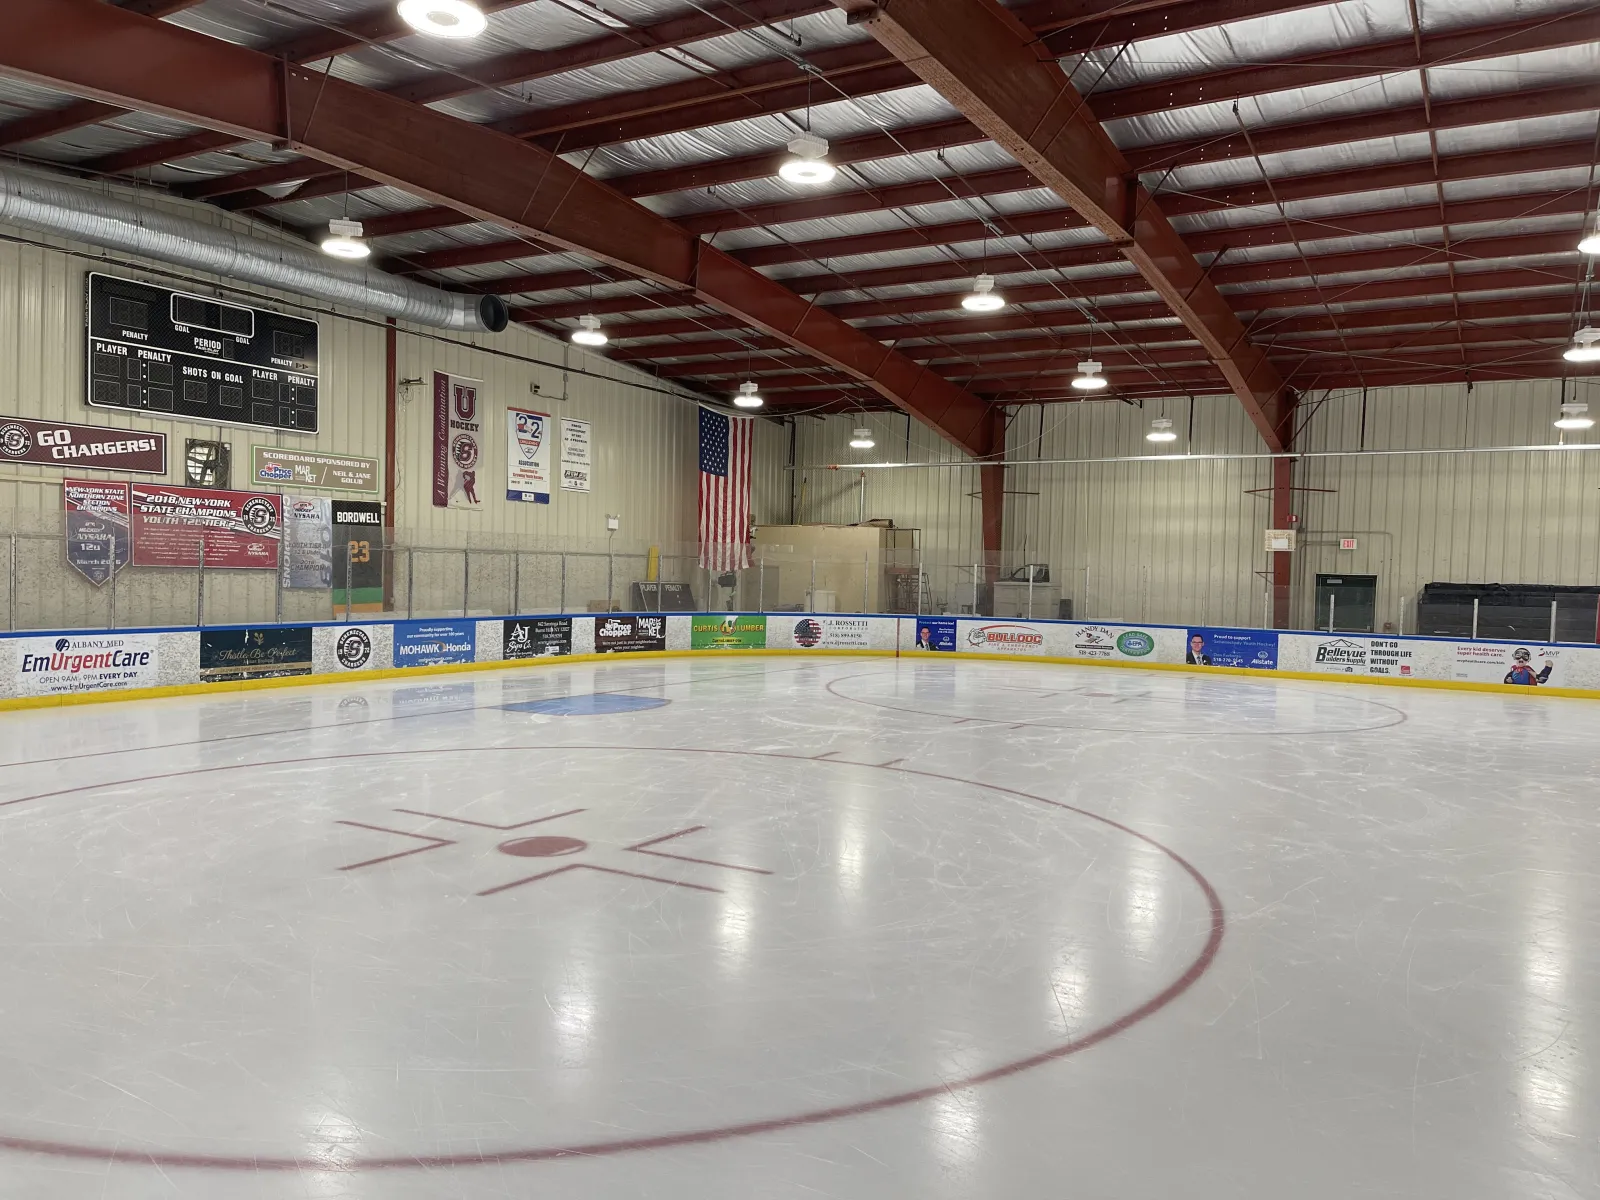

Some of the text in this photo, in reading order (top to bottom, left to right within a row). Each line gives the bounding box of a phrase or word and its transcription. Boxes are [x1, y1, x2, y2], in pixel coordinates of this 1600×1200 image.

[174, 324, 190, 333] GOAL
[122, 329, 149, 341] PENALTY
[235, 336, 250, 345] GOAL
[194, 337, 221, 350] PERIOD
[97, 342, 171, 363] PLAYER PENALTY
[270, 357, 293, 367] PENALTY
[182, 366, 244, 383] SHOTS ON GOAL
[252, 369, 315, 387] PLAYER PENALTY
[453, 384, 476, 421] U
[437, 379, 447, 440] Combination
[450, 419, 480, 432] HOCKEY
[36, 429, 72, 447] GO
[51, 438, 157, 460] CHARGERS!
[262, 451, 371, 469] SCOREBOARD SPONSORED BY
[274, 466, 292, 475] Price
[294, 464, 311, 475] MAR
[437, 445, 448, 487] Winning
[259, 469, 294, 481] Chopper
[355, 471, 372, 480] JANE
[69, 491, 125, 501] NORTHERN ZONE
[104, 488, 125, 496] STATE
[146, 494, 175, 504] 2018
[140, 504, 237, 518] STATE CHAMPIONS
[293, 512, 320, 520] NYSAHA
[142, 515, 179, 525] YOUTH
[337, 511, 380, 523] BORDWELL
[1342, 540, 1355, 548] EXIT
[347, 540, 370, 563] 23
[599, 627, 632, 637] Chopper
[612, 623, 632, 631] Price
[738, 624, 764, 632] LUMBER
[1075, 625, 1115, 639] HANDY DAN
[71, 639, 124, 650] ALBANY MED
[985, 632, 1044, 646] BULLDOG
[400, 641, 471, 656] MOHAWK Honda
[1389, 641, 1398, 649] GO
[1315, 646, 1367, 663] Bellevue
[1370, 650, 1413, 659] THROUGH LIFE
[22, 650, 150, 673] EmUrgentCare
[1250, 658, 1274, 666] Allstate
[1346, 657, 1367, 665] Supply
[1370, 658, 1399, 666] WITHOUT
[1370, 666, 1391, 674] GOALS.
[39, 671, 138, 684] OPEN 9AM 9PM EVERY DAY
